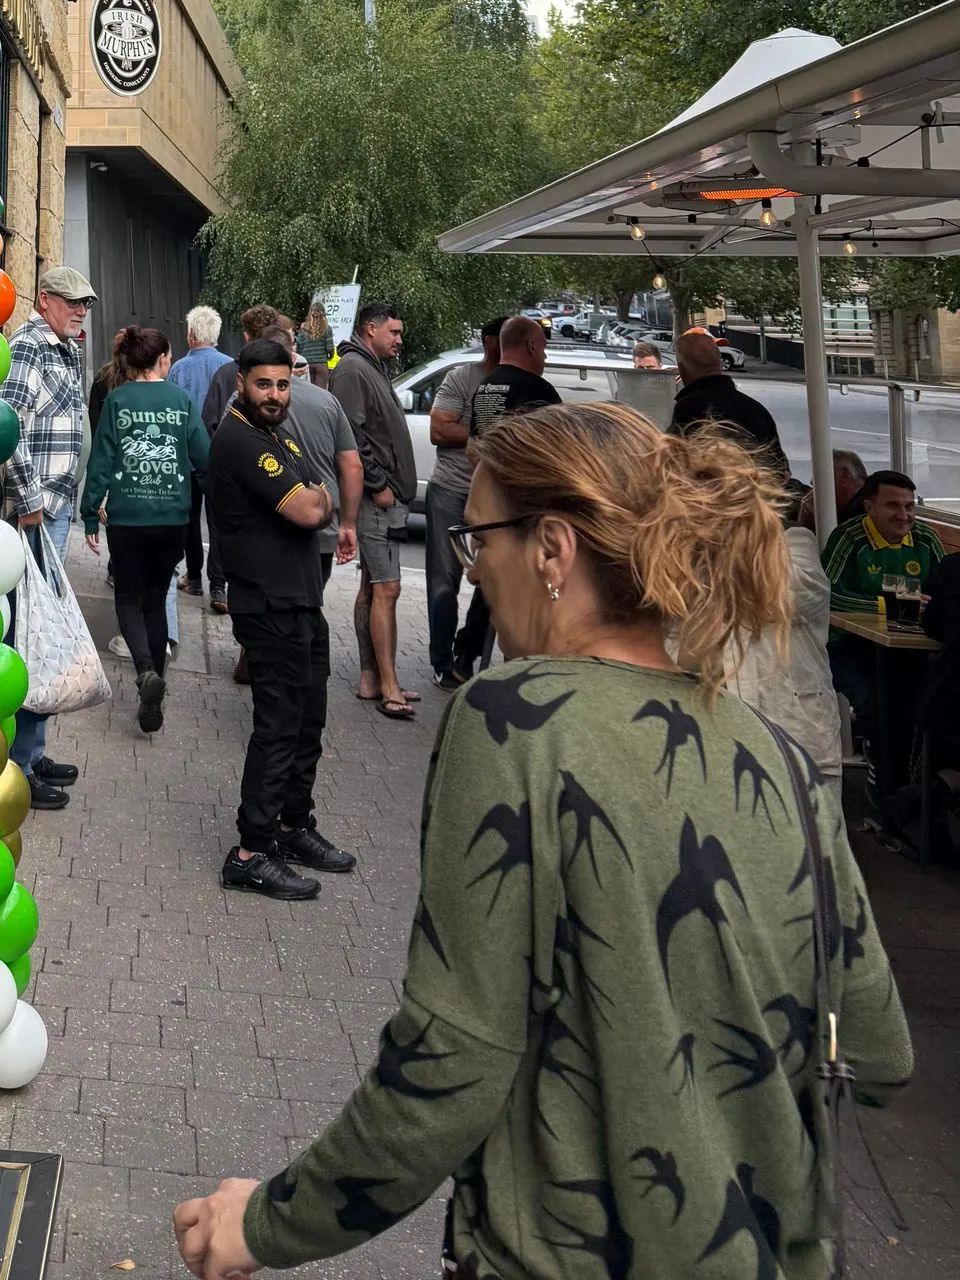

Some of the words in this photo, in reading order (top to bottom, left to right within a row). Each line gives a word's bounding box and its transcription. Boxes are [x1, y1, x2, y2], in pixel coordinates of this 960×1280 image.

[111, 11, 143, 25] IRISH
[325, 304, 340, 316] 2P
[116, 407, 190, 430] Sunset
[122, 455, 179, 476] Lover
[139, 474, 163, 486] Club
